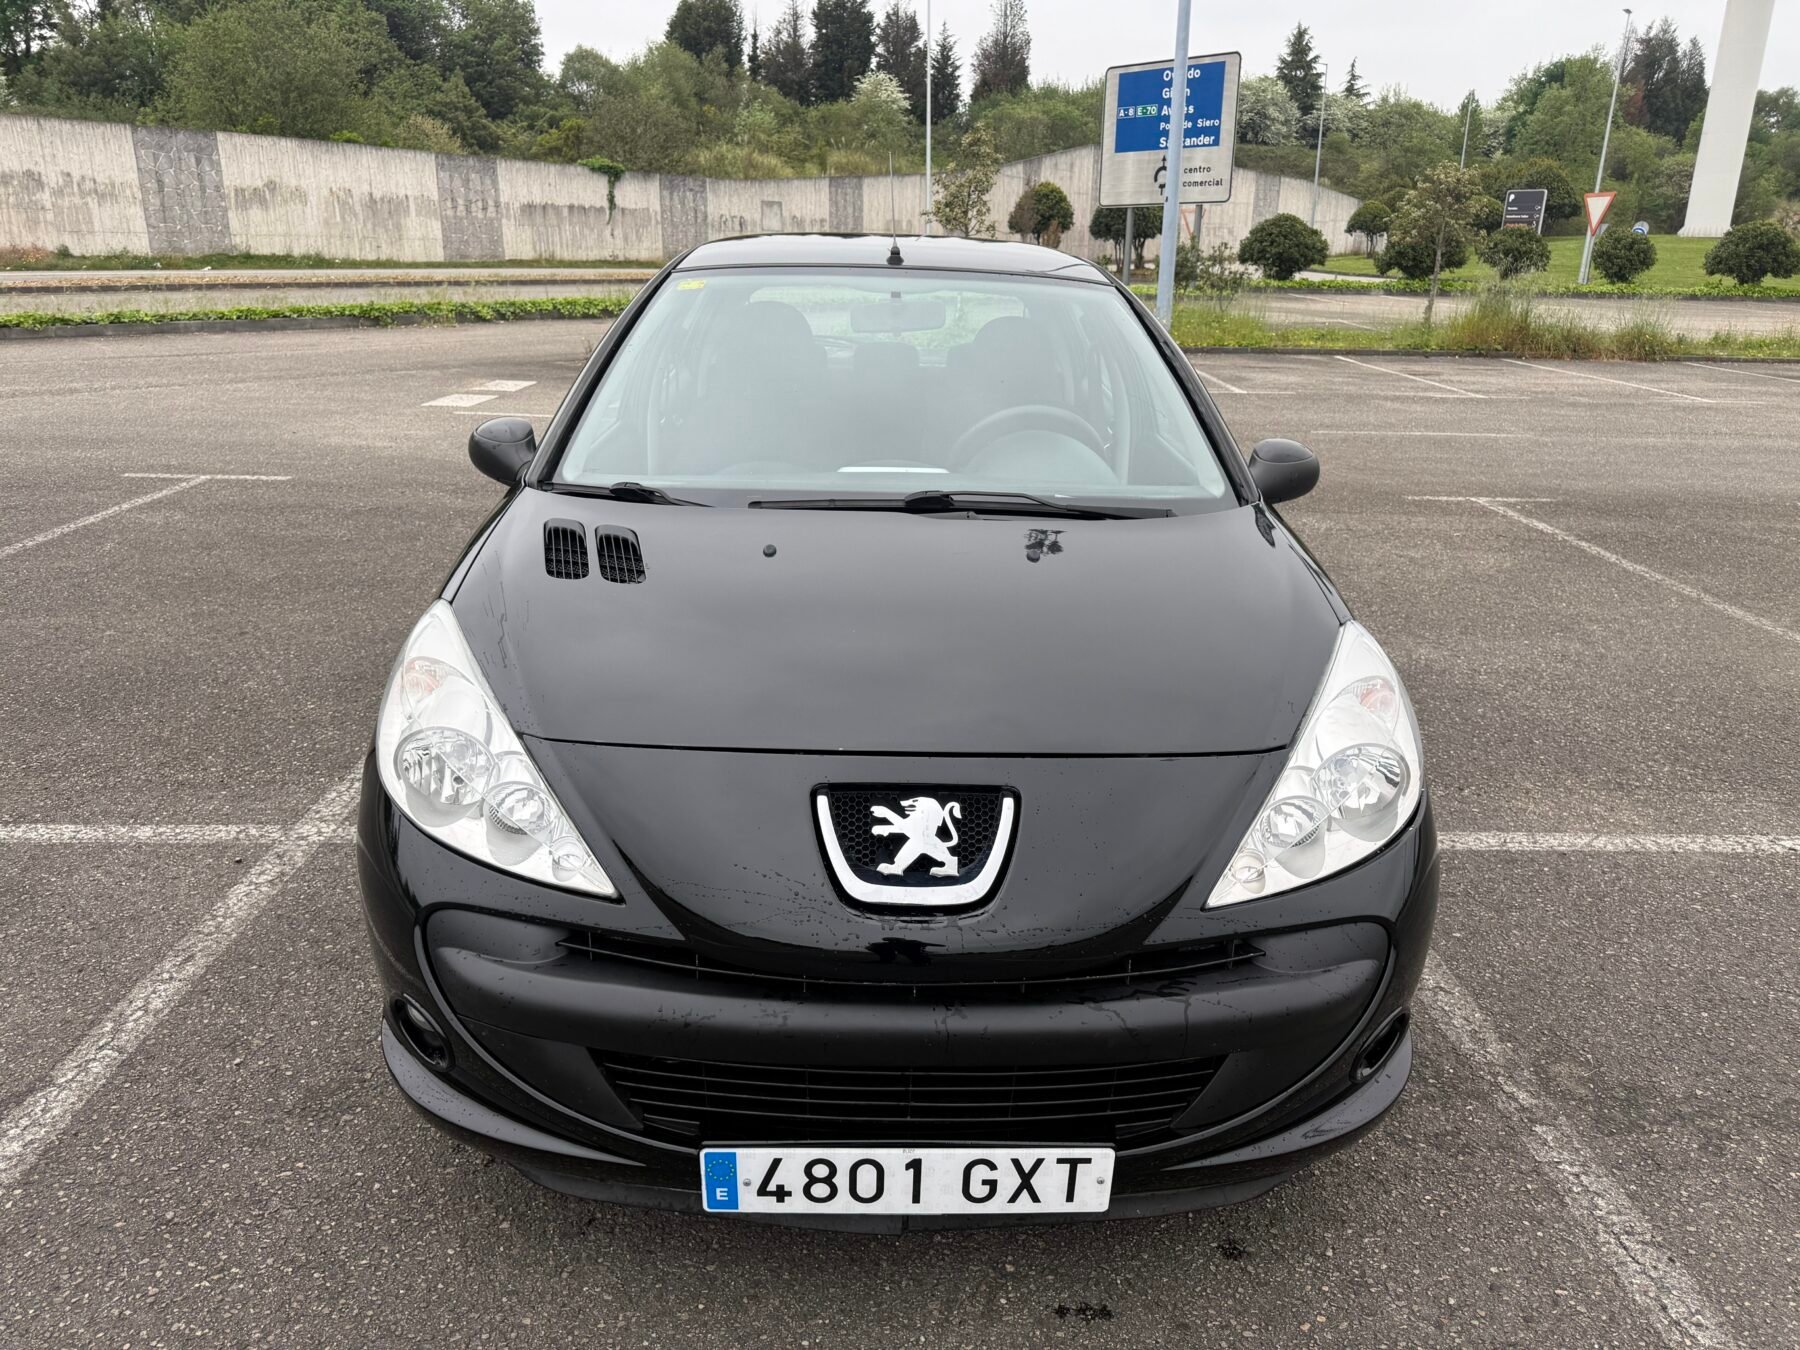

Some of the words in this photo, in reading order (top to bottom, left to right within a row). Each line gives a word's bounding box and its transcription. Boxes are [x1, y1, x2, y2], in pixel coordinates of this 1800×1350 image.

[1163, 68, 1201, 81] Odo
[1162, 88, 1190, 98] Gin
[1119, 107, 1134, 117] A-8
[1137, 106, 1157, 115] E-70
[1197, 118, 1220, 127] Siero
[1159, 134, 1215, 148] Sander
[1183, 165, 1212, 174] centro
[1182, 178, 1223, 188] comercial
[756, 1157, 924, 1205] 4801
[961, 1157, 1093, 1205] GXT
[716, 1187, 729, 1201] E
